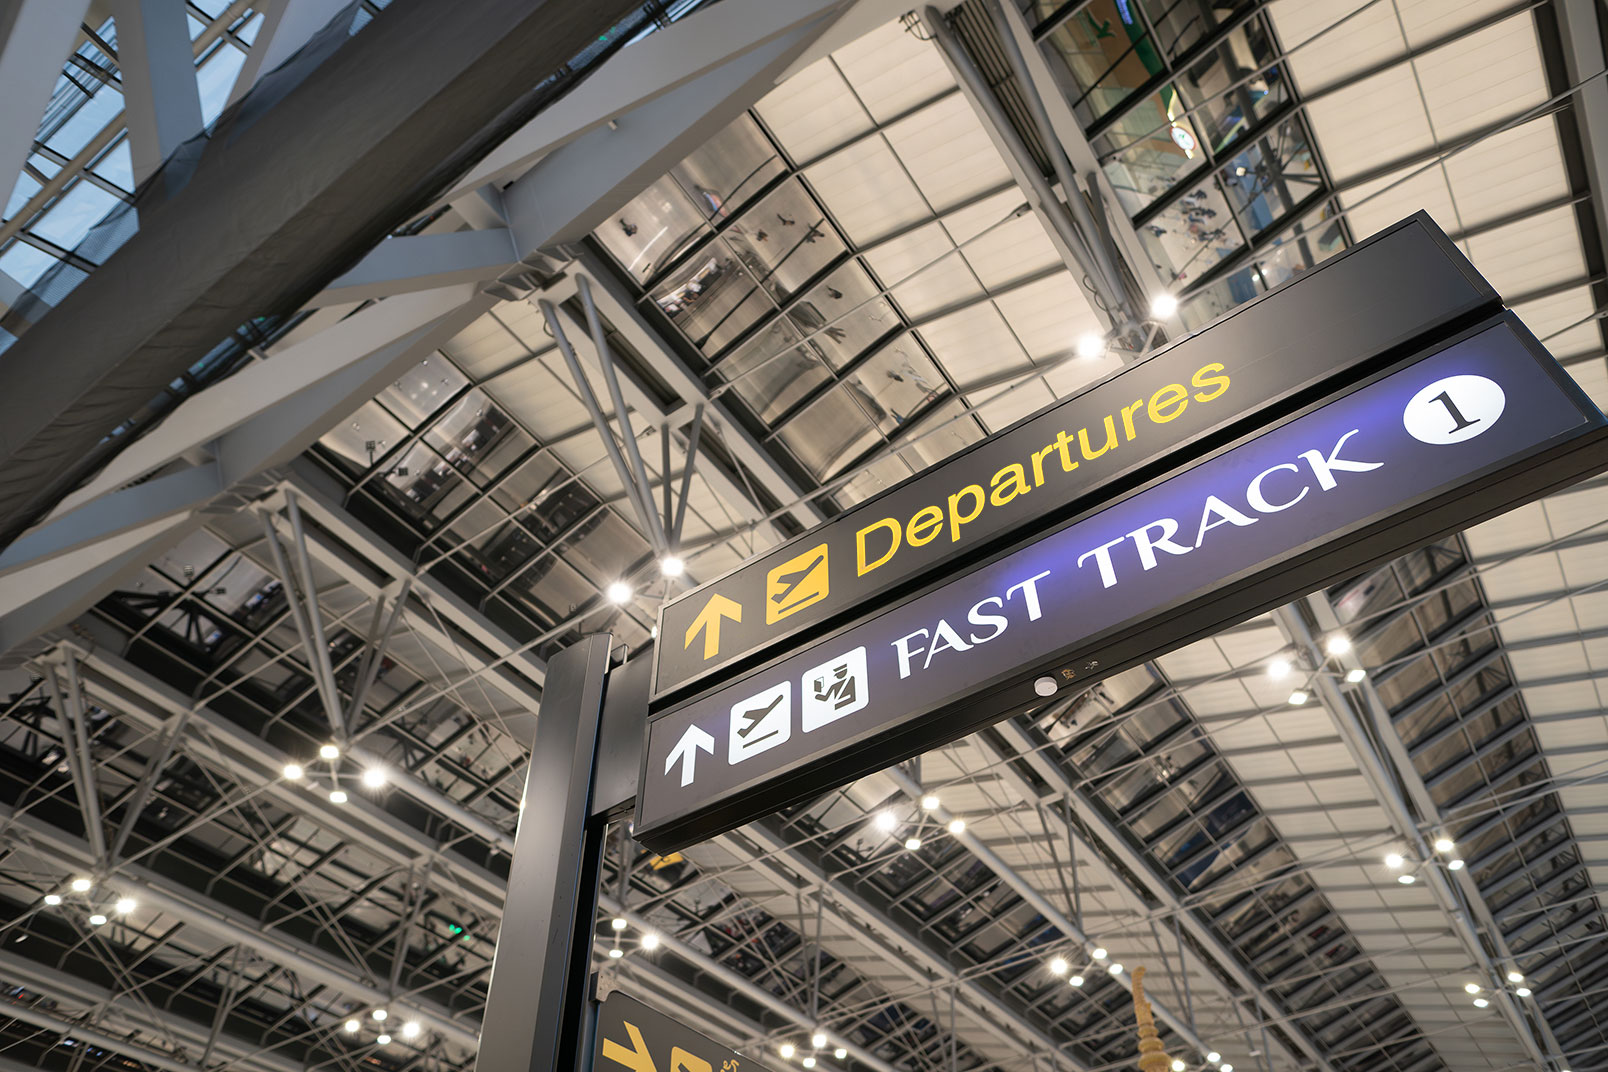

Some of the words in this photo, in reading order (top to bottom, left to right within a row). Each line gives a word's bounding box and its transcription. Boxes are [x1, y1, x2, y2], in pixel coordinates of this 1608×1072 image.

[855, 361, 1231, 577] Departures
[890, 570, 1051, 680] FAST
[1077, 428, 1385, 589] TRACK
[1428, 390, 1481, 435] 1
